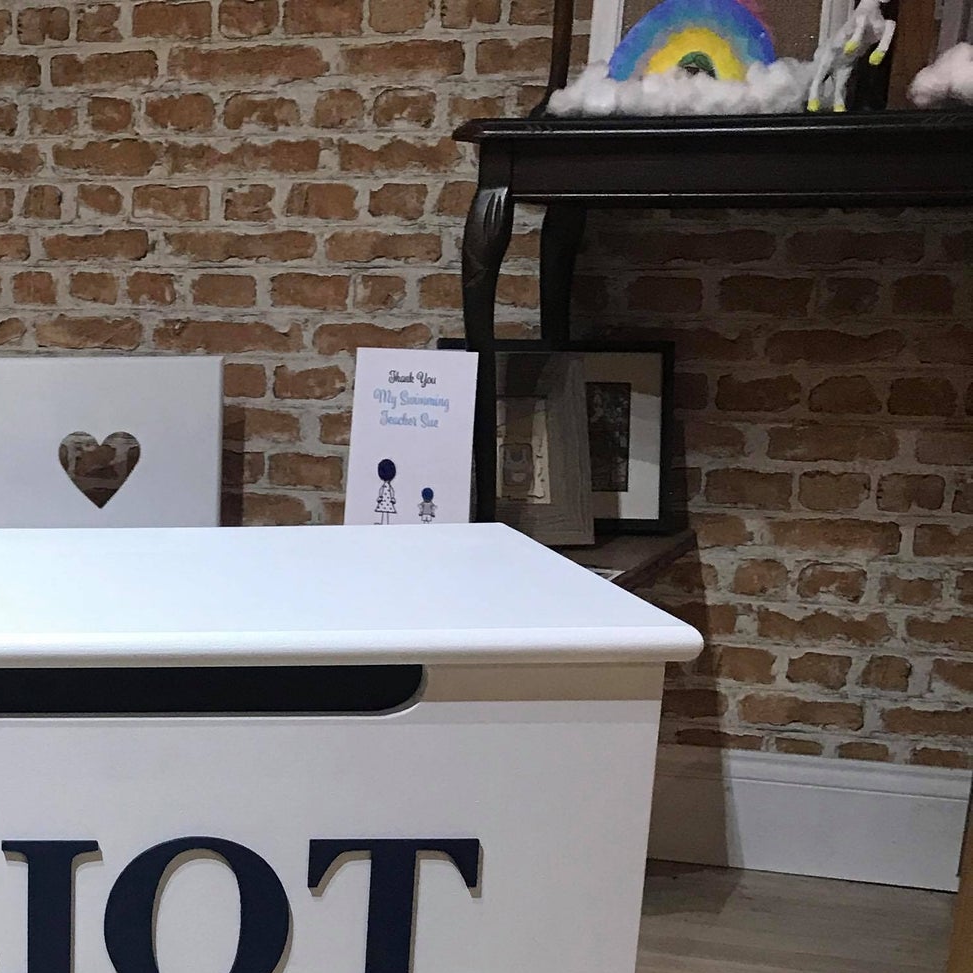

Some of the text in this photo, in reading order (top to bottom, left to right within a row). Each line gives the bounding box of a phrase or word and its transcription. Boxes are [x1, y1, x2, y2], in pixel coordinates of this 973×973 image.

[388, 370, 437, 388] Thank You
[373, 388, 450, 413] My Swimming
[380, 410, 439, 428] Teacher Sue
